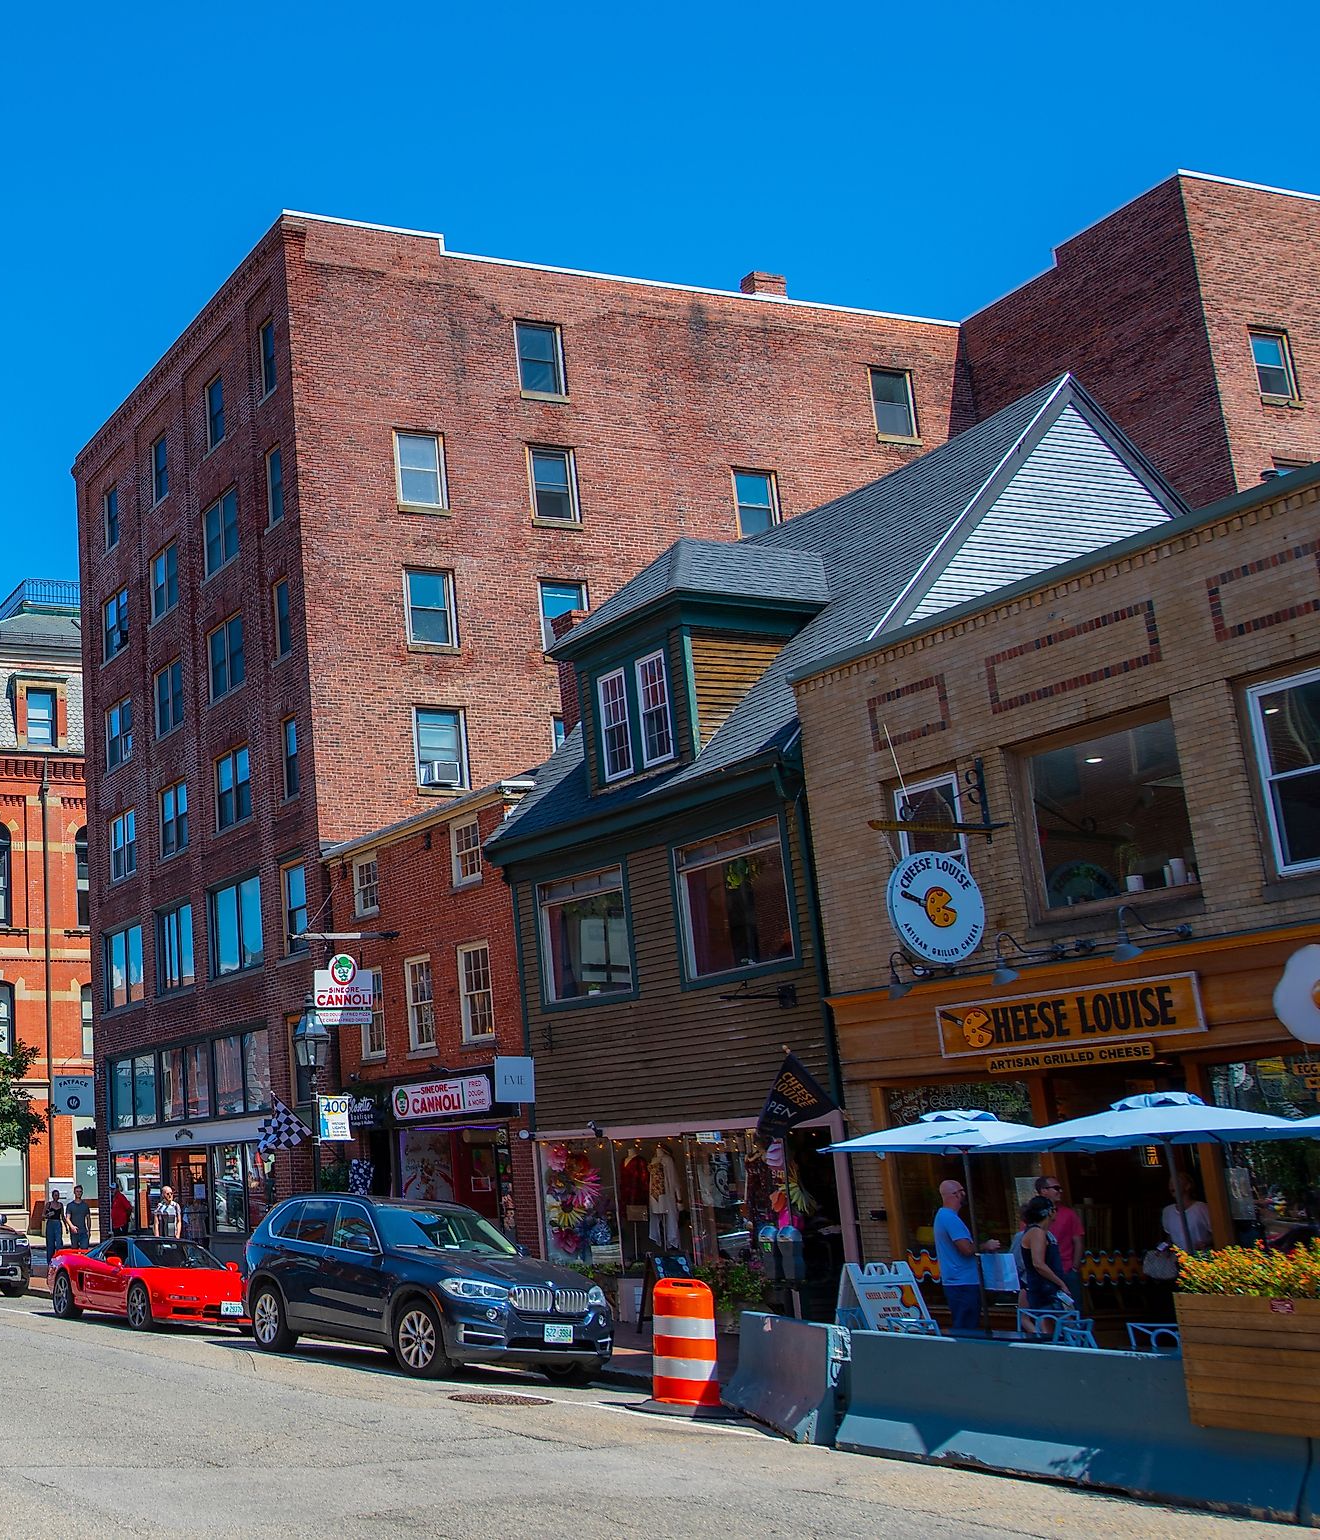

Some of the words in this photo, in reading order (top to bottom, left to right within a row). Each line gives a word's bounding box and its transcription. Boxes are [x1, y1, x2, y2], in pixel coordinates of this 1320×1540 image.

[900, 857, 932, 889] CHEESE
[935, 857, 972, 890] LOUISE
[903, 922, 928, 951] ARTISAN
[932, 947, 959, 957] GRILLED
[961, 924, 979, 950] CHEESE
[317, 994, 372, 1006] CANNOLI
[1076, 985, 1176, 1034] LOUISE
[990, 1056, 1040, 1071] ARTISAN
[1043, 1051, 1094, 1066] GRILLED
[1098, 1045, 1151, 1059] CHEESE
[59, 1079, 89, 1088] FATFACE
[504, 1075, 525, 1085] EVIE
[782, 1072, 818, 1106] CHEESE
[324, 1100, 347, 1113] 400
[412, 1093, 461, 1114] CANNOLI
[766, 1100, 798, 1118] PEN
